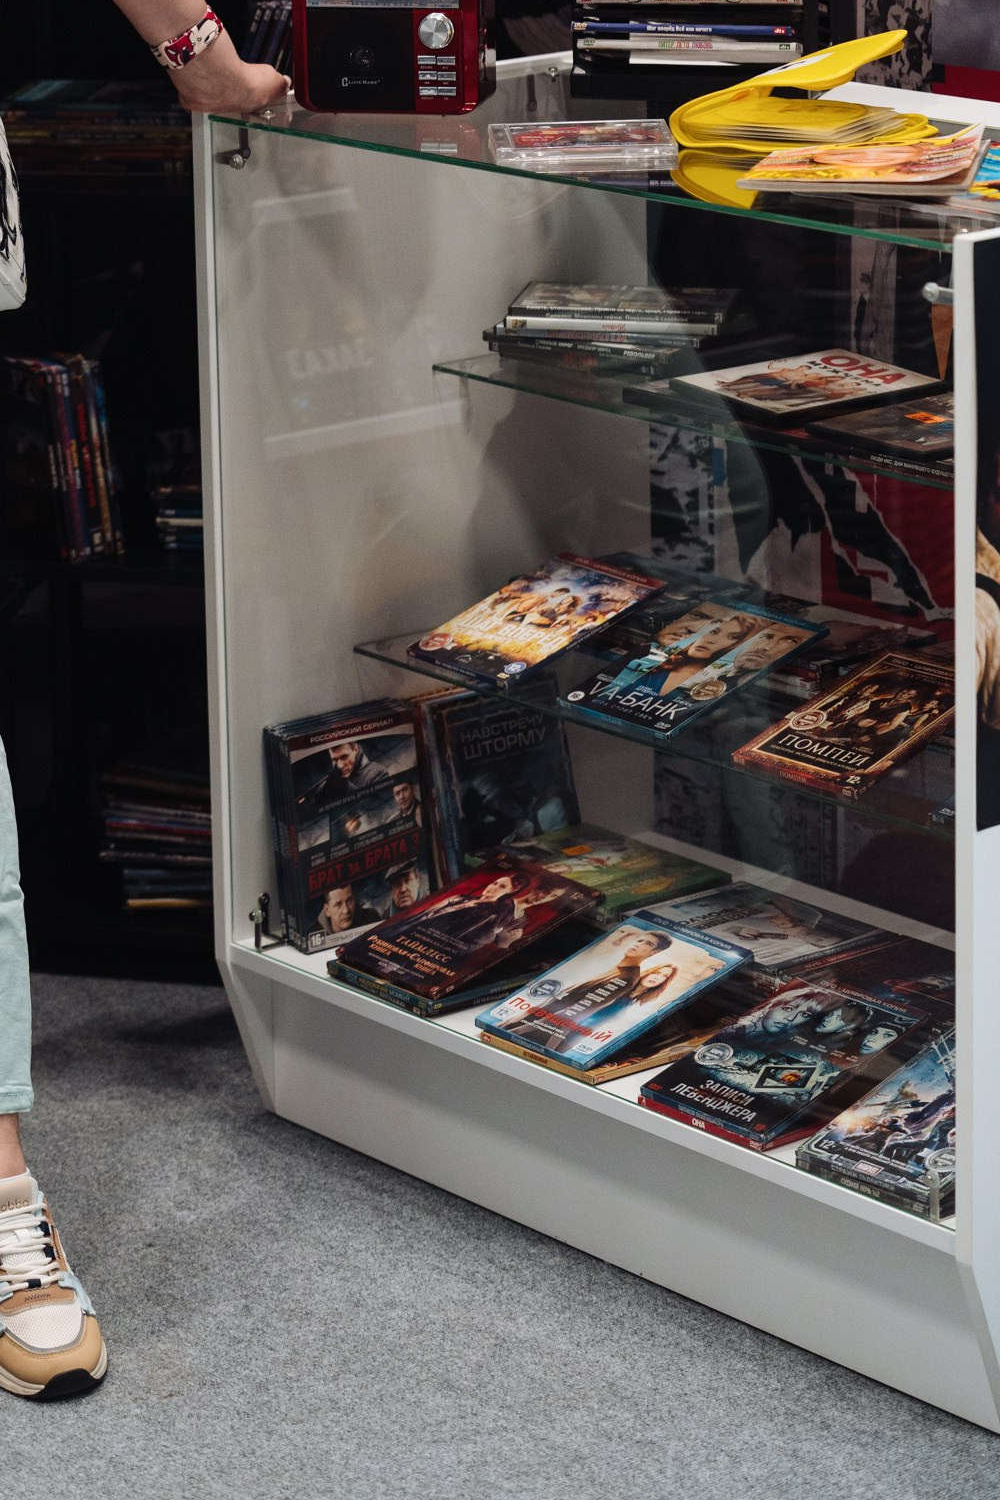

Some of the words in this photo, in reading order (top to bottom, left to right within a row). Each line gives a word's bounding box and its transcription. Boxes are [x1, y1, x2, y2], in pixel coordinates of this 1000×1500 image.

[647, 25, 657, 33] Шаг
[623, 350, 656, 360] РЕВОЛЬВЕР
[820, 354, 908, 386] ОНА
[869, 454, 884, 463] ЛЮДИ
[903, 460, 931, 475] МИНУВШЕГО
[610, 703, 633, 715] СТОИТ
[309, 722, 362, 744] РОССИЙСКИЙ
[362, 718, 394, 731] СЕРИАЛ
[460, 713, 546, 743] НАВСТРЕЧУ
[463, 727, 548, 761] ШТОРМУ
[777, 733, 872, 769] ПОМПЕИ
[308, 864, 343, 893] БРАТ
[364, 841, 408, 868] БРАТА
[411, 834, 420, 852] 3
[309, 933, 325, 947] 16+
[652, 916, 670, 926] DVD
[672, 923, 707, 940] ЦИФРОВАЯ
[708, 936, 733, 951] КОПИЯ
[397, 936, 453, 964] ТАЙМЛЕСС
[842, 986, 882, 1006] ЦИФРОВАЯ
[881, 999, 908, 1014] КОПИЯ
[507, 995, 614, 1044] ПОСВЯЩЕННЫЙ
[670, 1081, 758, 1124] ЛЕВЕНДЖЕРА
[699, 1078, 754, 1106] ЗАПИСИ
[691, 1117, 706, 1131] ОНА
[817, 1138, 837, 1150] 12+
[830, 1163, 858, 1179] СТРАЖИ
[858, 1172, 896, 1191] ГАЛАКТИКИ
[856, 1161, 880, 1176] MARVEL
